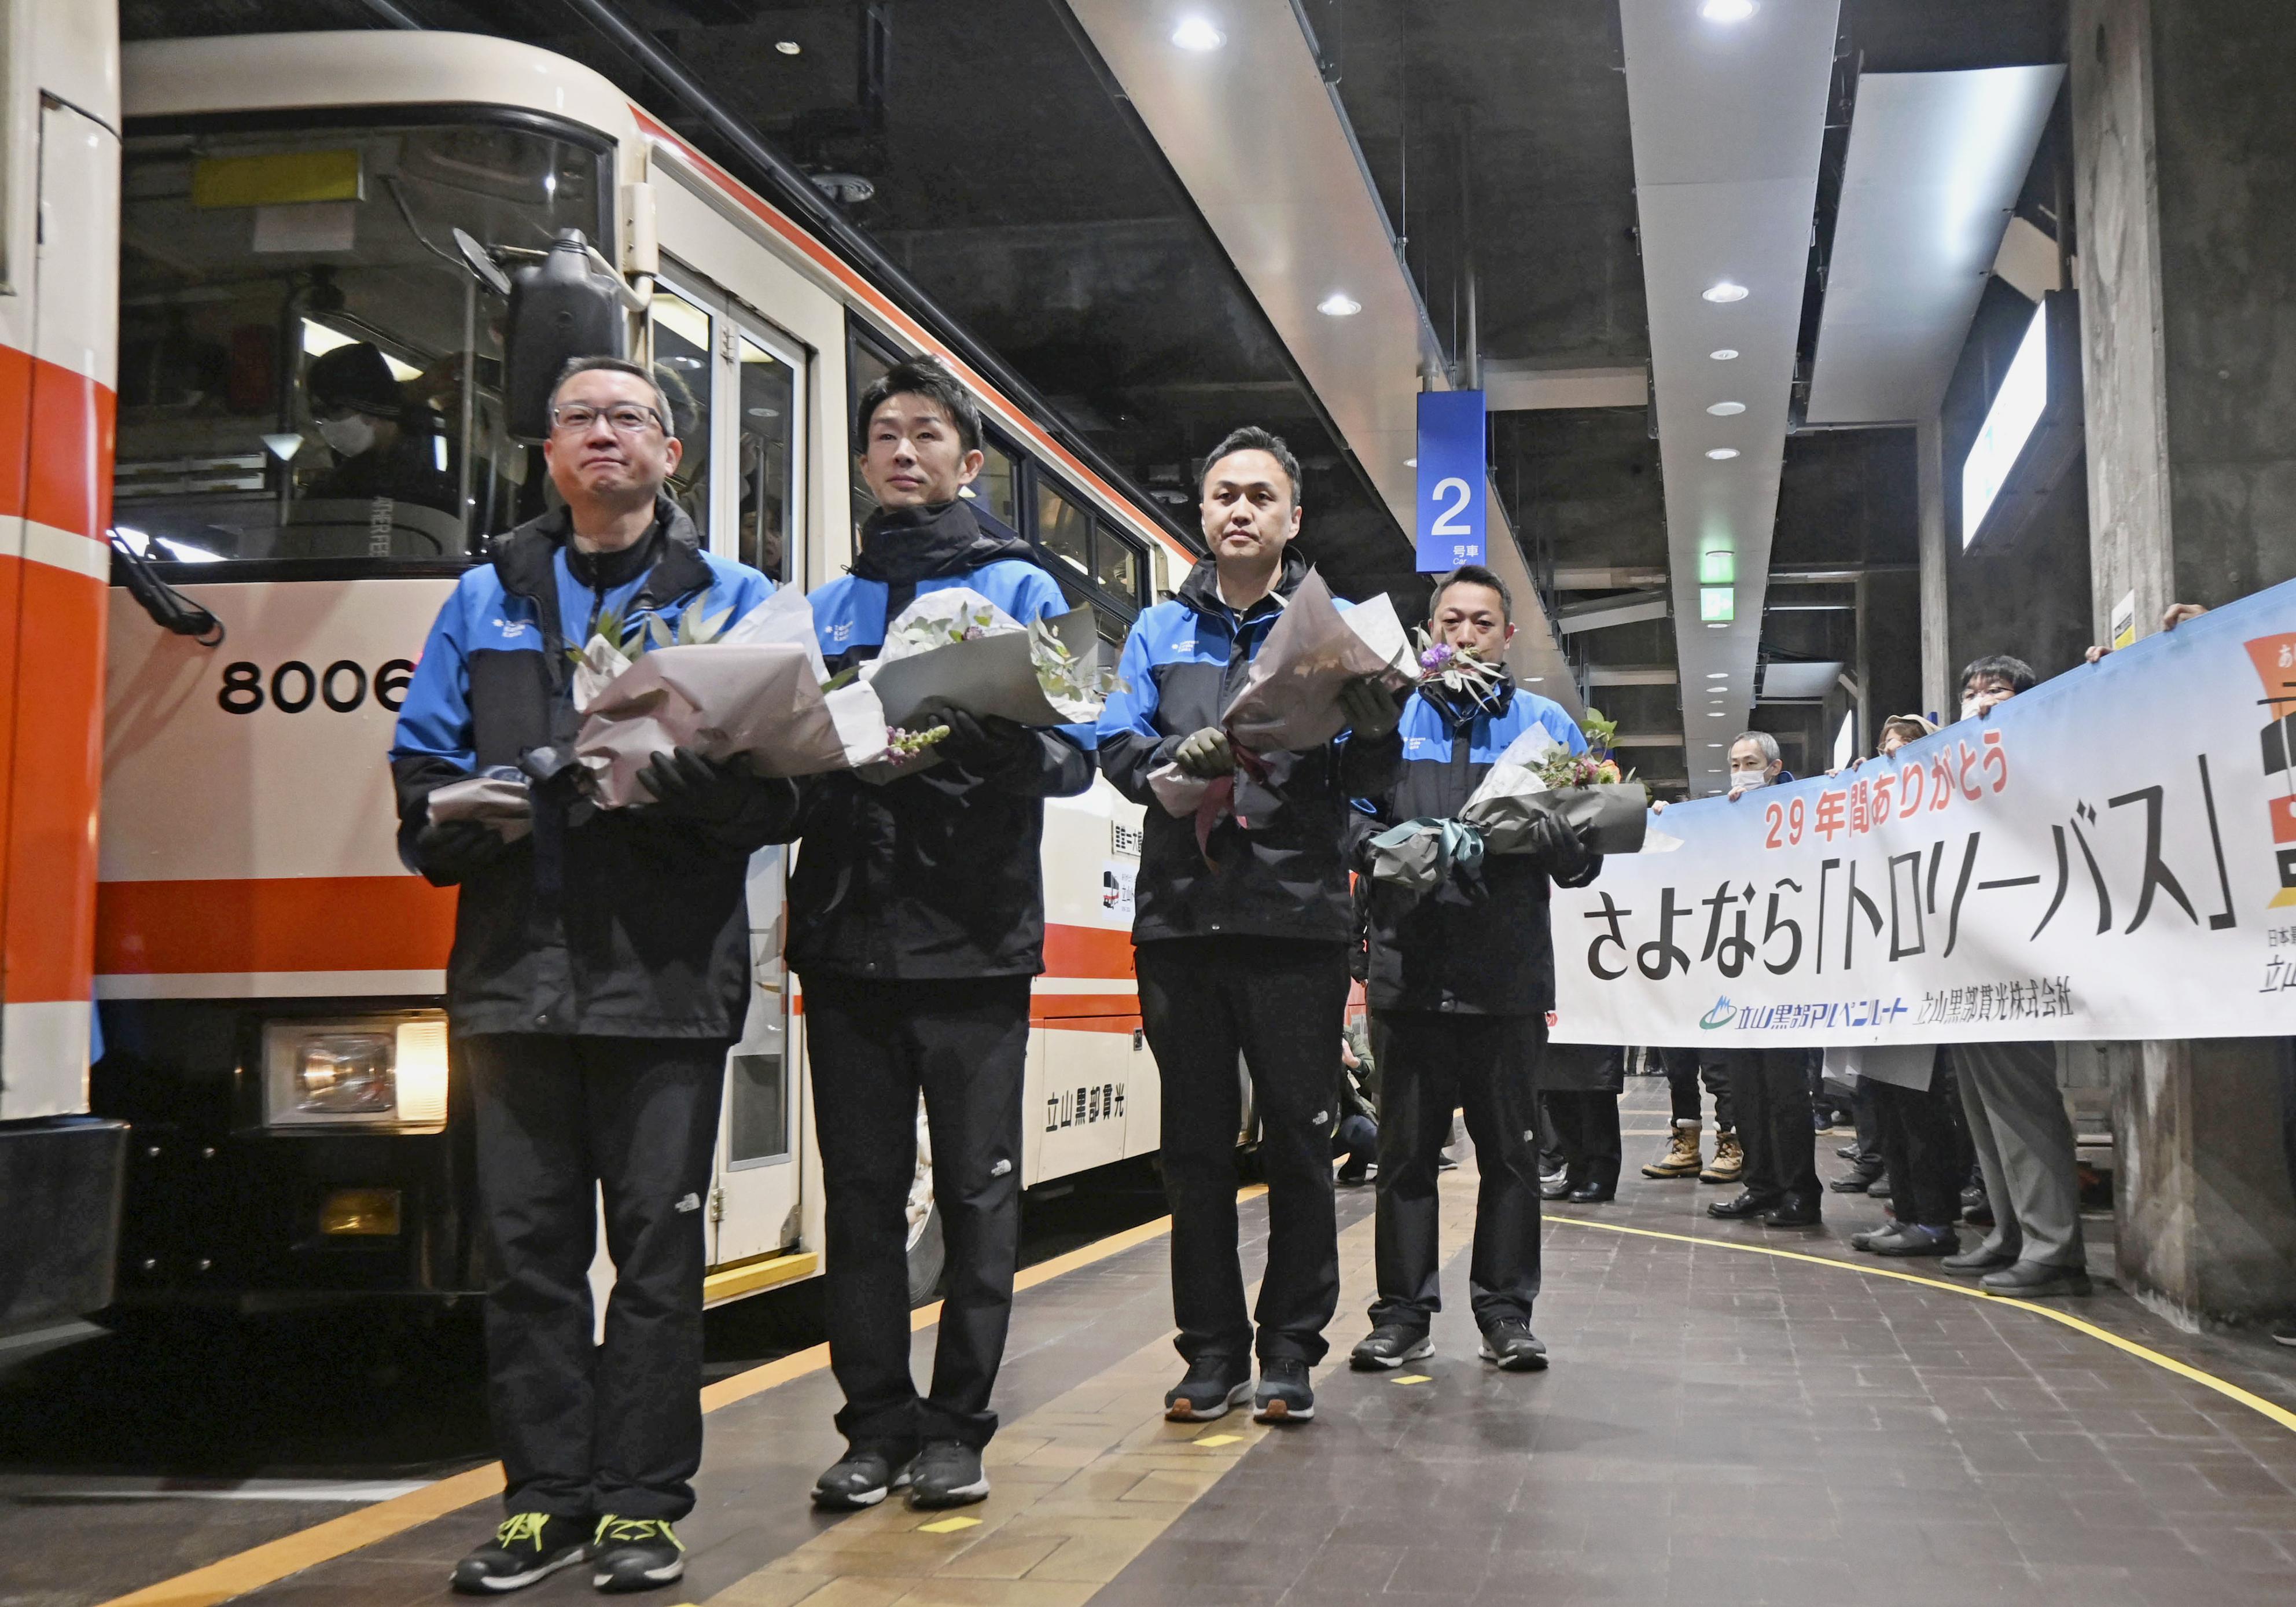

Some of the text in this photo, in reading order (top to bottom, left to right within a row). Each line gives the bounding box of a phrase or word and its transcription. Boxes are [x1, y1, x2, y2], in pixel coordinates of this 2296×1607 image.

[1431, 477, 1471, 535] 2
[1453, 545, 1479, 557] 号車
[2278, 643, 2296, 668] あ
[219, 659, 417, 715] 8006
[1765, 729, 2008, 849] 29年間ありがとう
[1583, 753, 2237, 980] さよなら「トロリーバス」
[1734, 976, 2074, 1029] 立山黒部アルペンルート 立山黒部貫光株式会社
[1045, 1082, 1125, 1132] 立山黒部貫光
